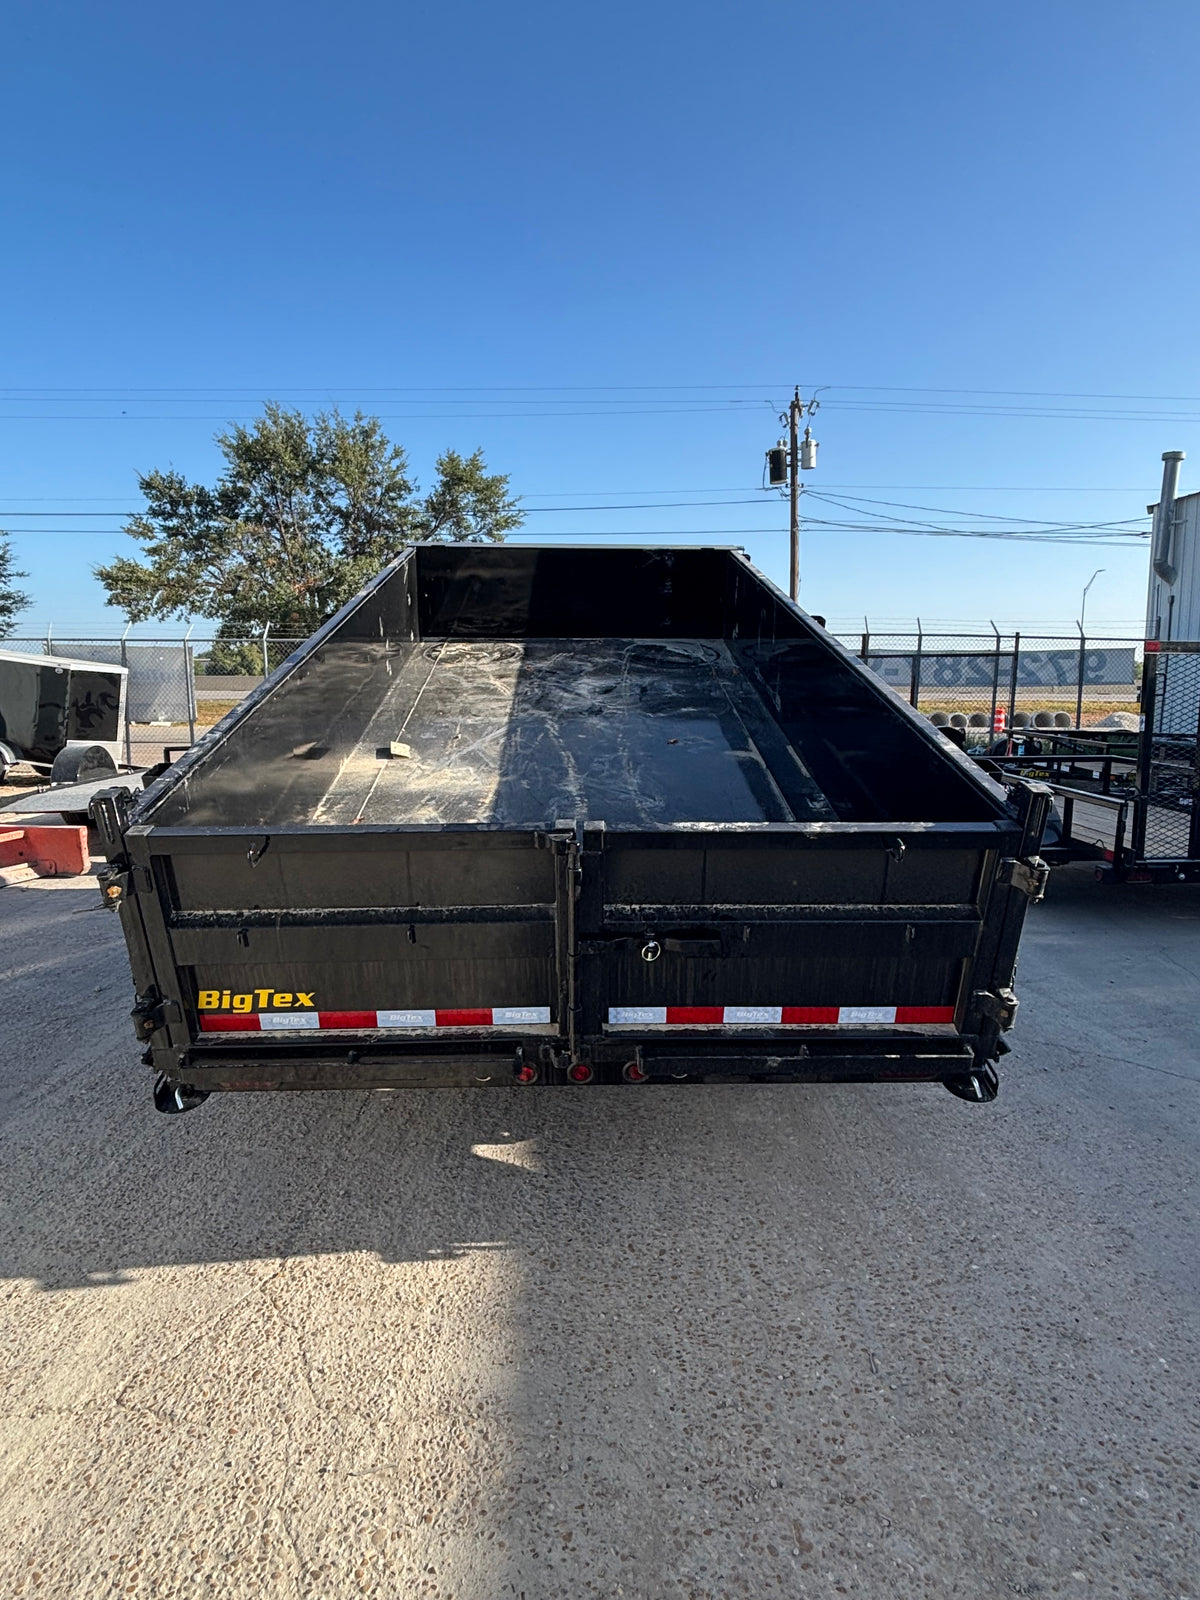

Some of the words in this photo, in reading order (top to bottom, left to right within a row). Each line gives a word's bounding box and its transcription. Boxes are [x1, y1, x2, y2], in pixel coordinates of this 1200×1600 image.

[197, 989, 315, 1013] BigTex
[389, 1014, 423, 1023] BigTex
[504, 1011, 538, 1020] BigTex
[272, 1016, 306, 1025] BigTex
